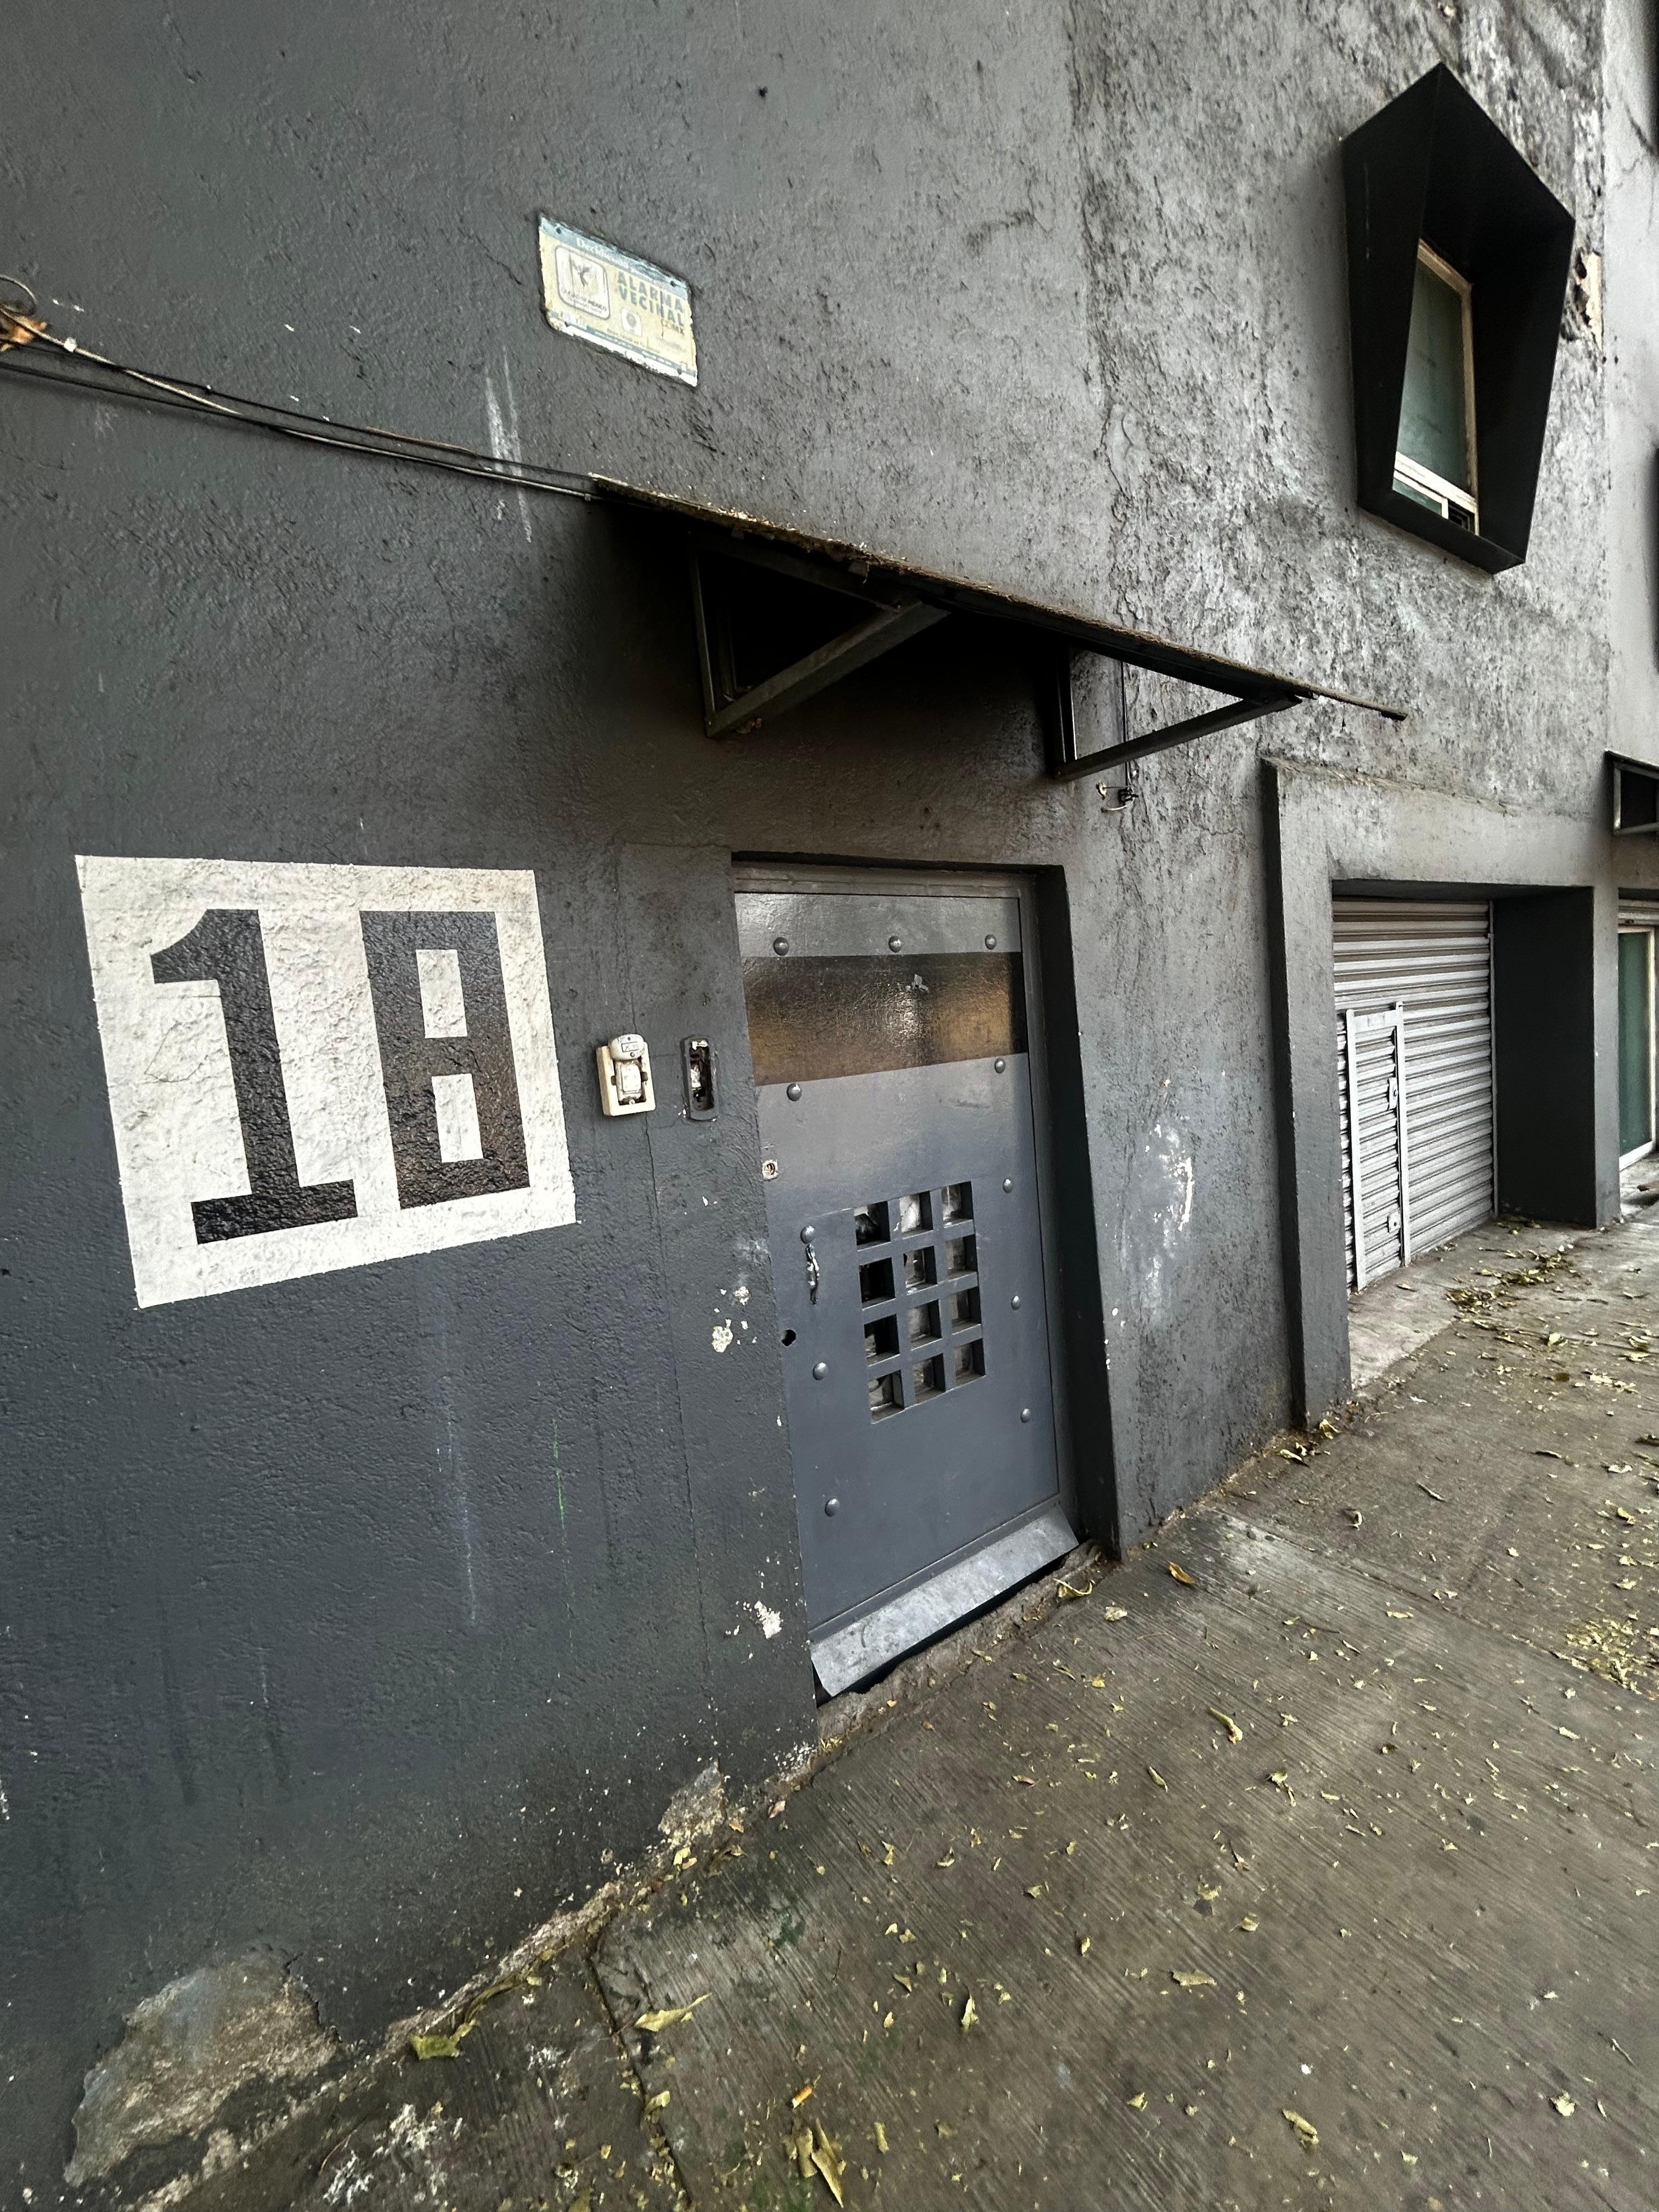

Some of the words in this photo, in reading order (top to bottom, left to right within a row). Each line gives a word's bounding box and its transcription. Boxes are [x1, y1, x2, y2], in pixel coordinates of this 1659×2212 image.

[618, 271, 684, 313] ALARMA
[618, 285, 685, 327] VECINAL
[150, 909, 531, 1245] 18
